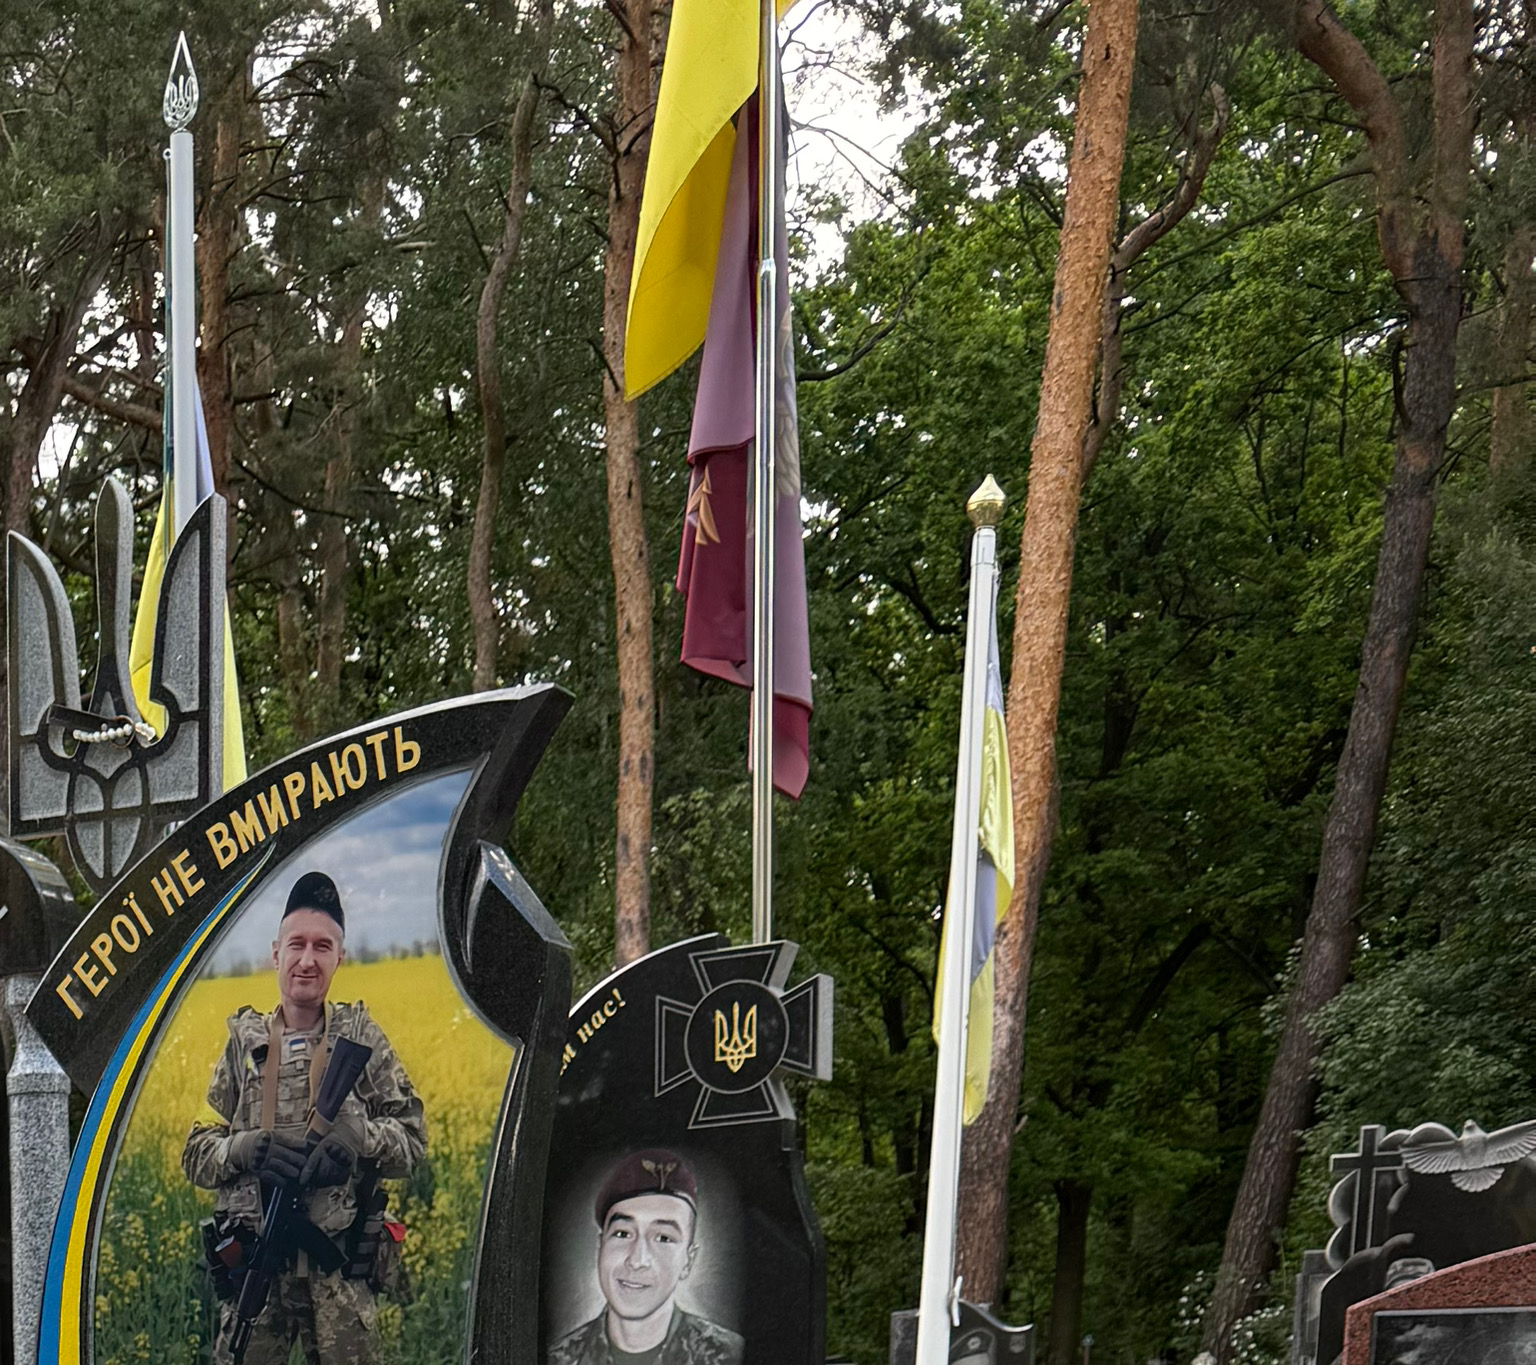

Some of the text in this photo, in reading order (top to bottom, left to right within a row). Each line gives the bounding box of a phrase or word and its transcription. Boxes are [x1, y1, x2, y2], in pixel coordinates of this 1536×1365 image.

[56, 726, 422, 1020] ГЕРОЇ НЕ ВМИРАЮТЬ
